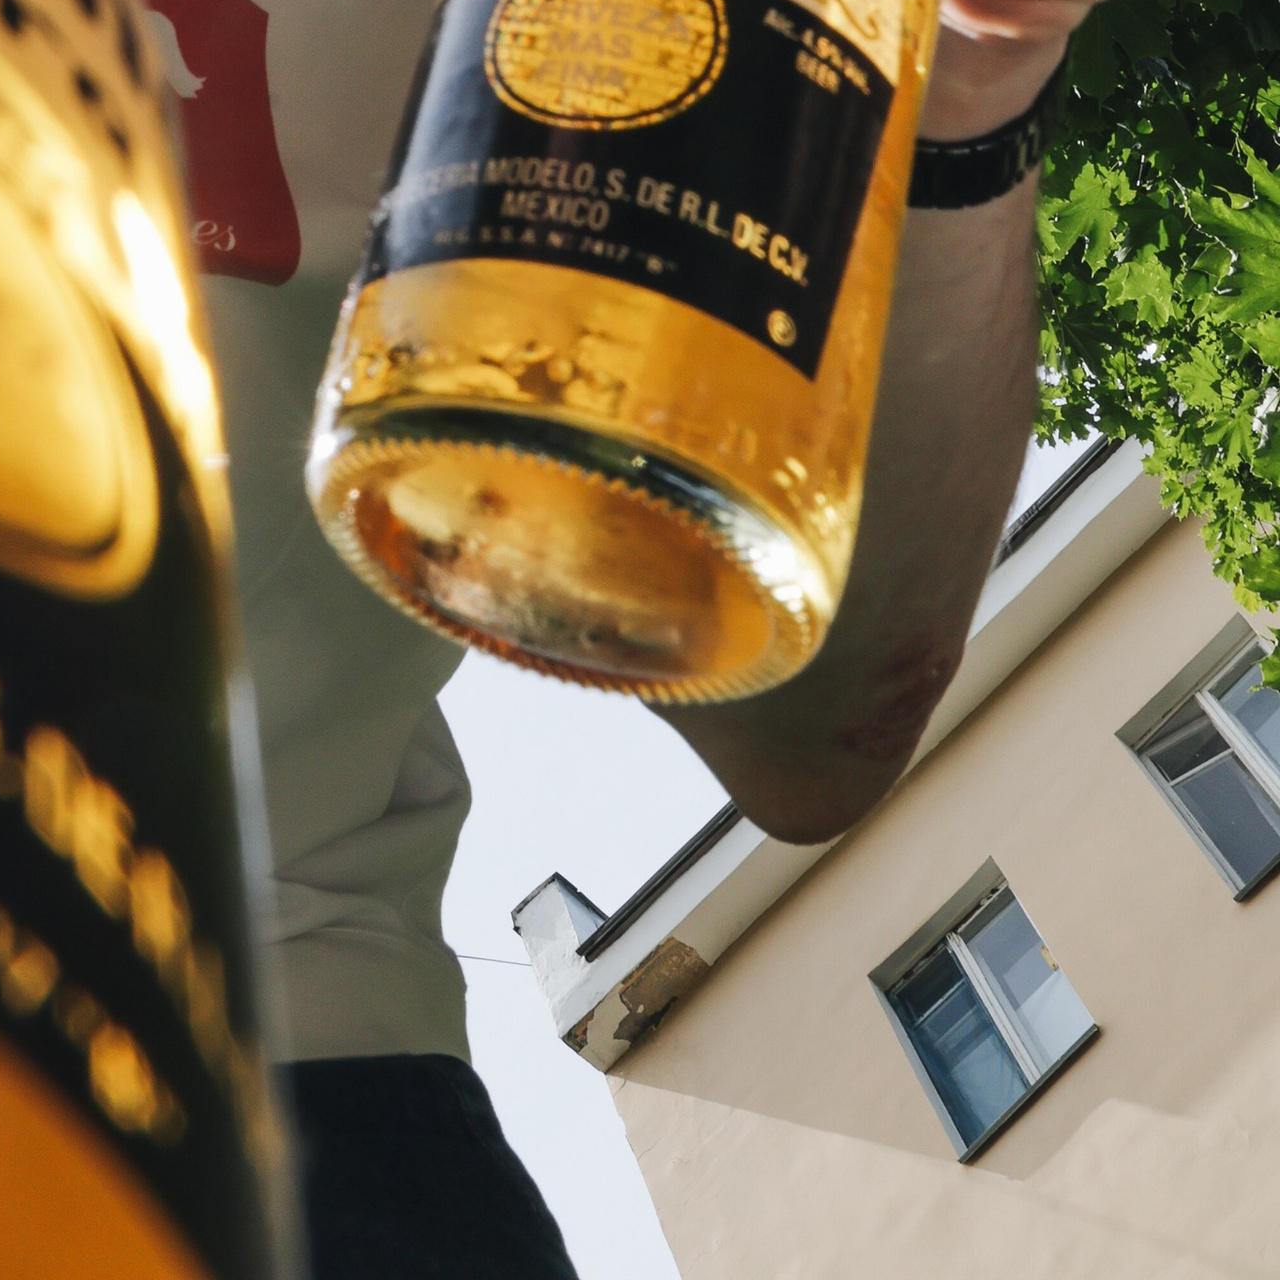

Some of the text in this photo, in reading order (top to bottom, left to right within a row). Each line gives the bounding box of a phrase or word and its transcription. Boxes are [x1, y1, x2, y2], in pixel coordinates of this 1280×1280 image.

[483, 156, 600, 197] MODELO,
[605, 168, 631, 204] S.
[636, 176, 675, 215] DE
[677, 190, 730, 239] R.L.
[732, 212, 770, 260] DE
[768, 233, 809, 287] C.V.
[500, 190, 610, 232] MEXICO
[192, 219, 237, 252] es
